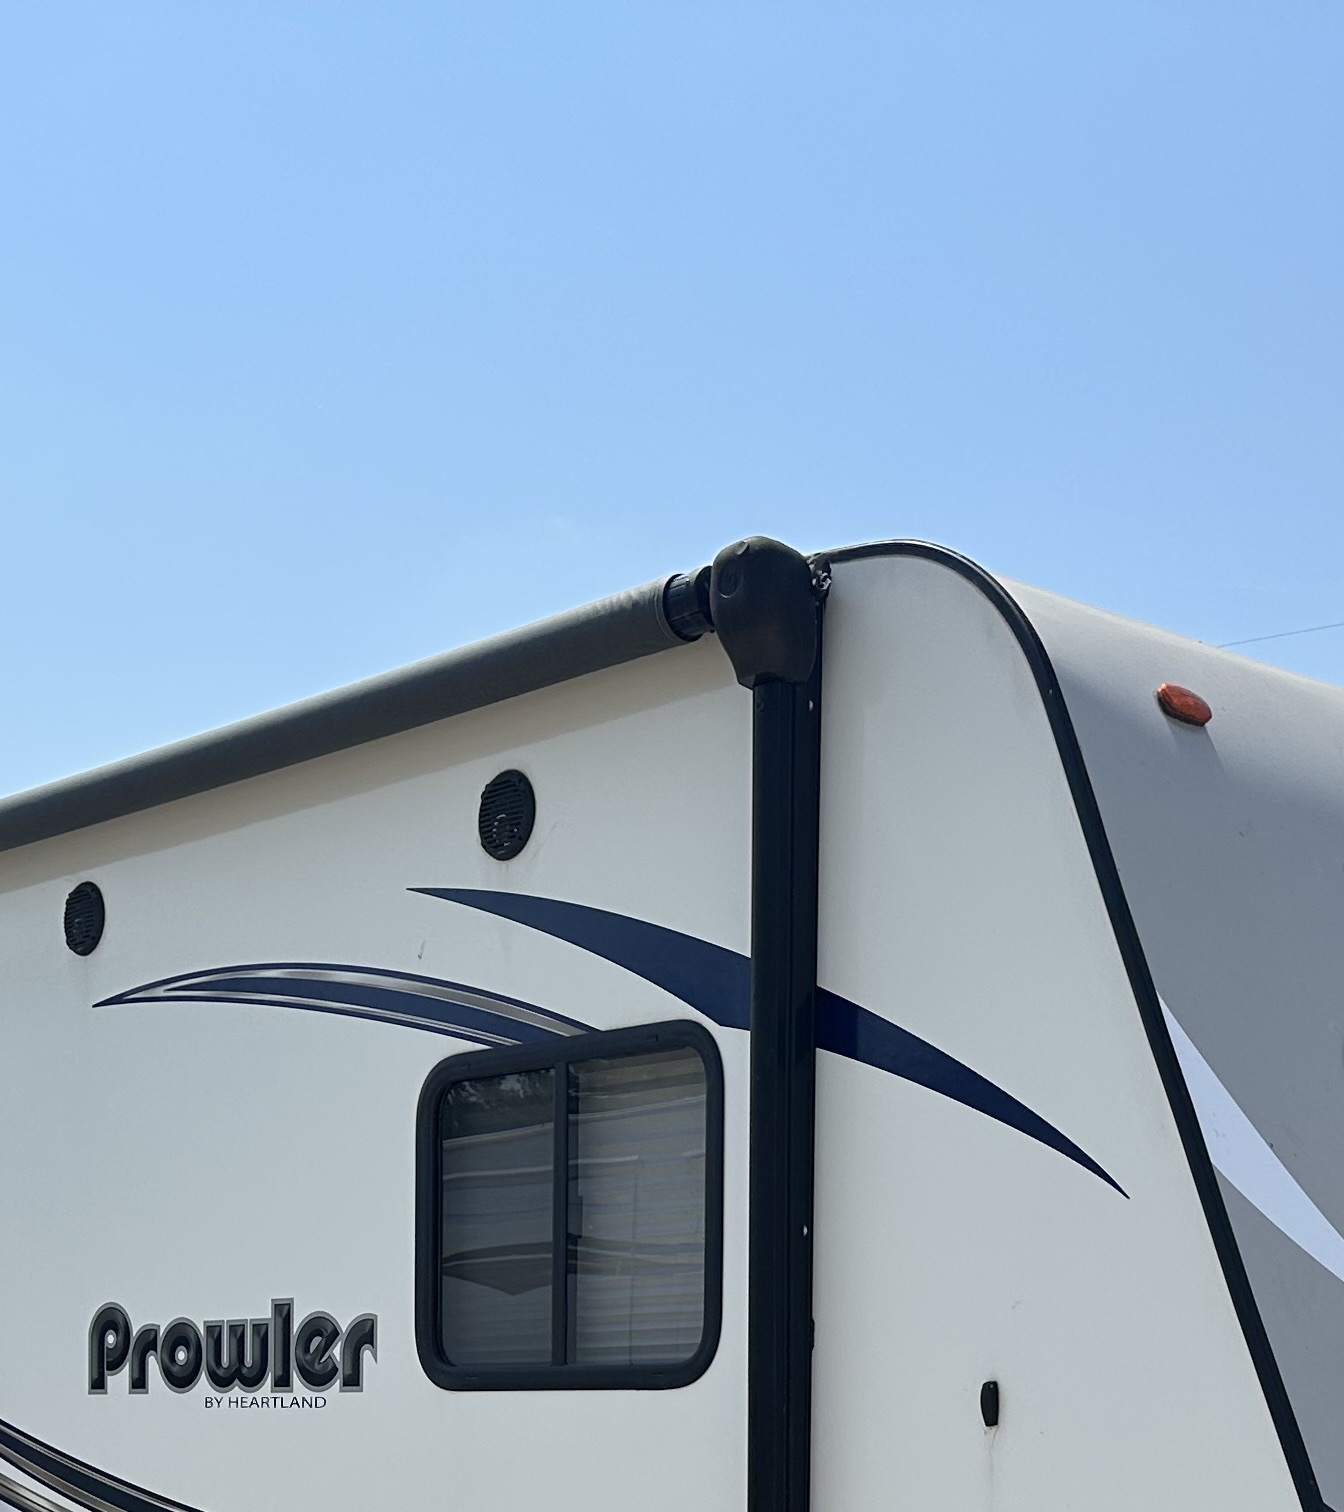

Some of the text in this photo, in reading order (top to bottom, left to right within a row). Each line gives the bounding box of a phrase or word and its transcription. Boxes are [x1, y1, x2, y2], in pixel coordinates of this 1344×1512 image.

[88, 1297, 378, 1395] Prowler
[204, 1396, 327, 1409] BY HEARTLAND
